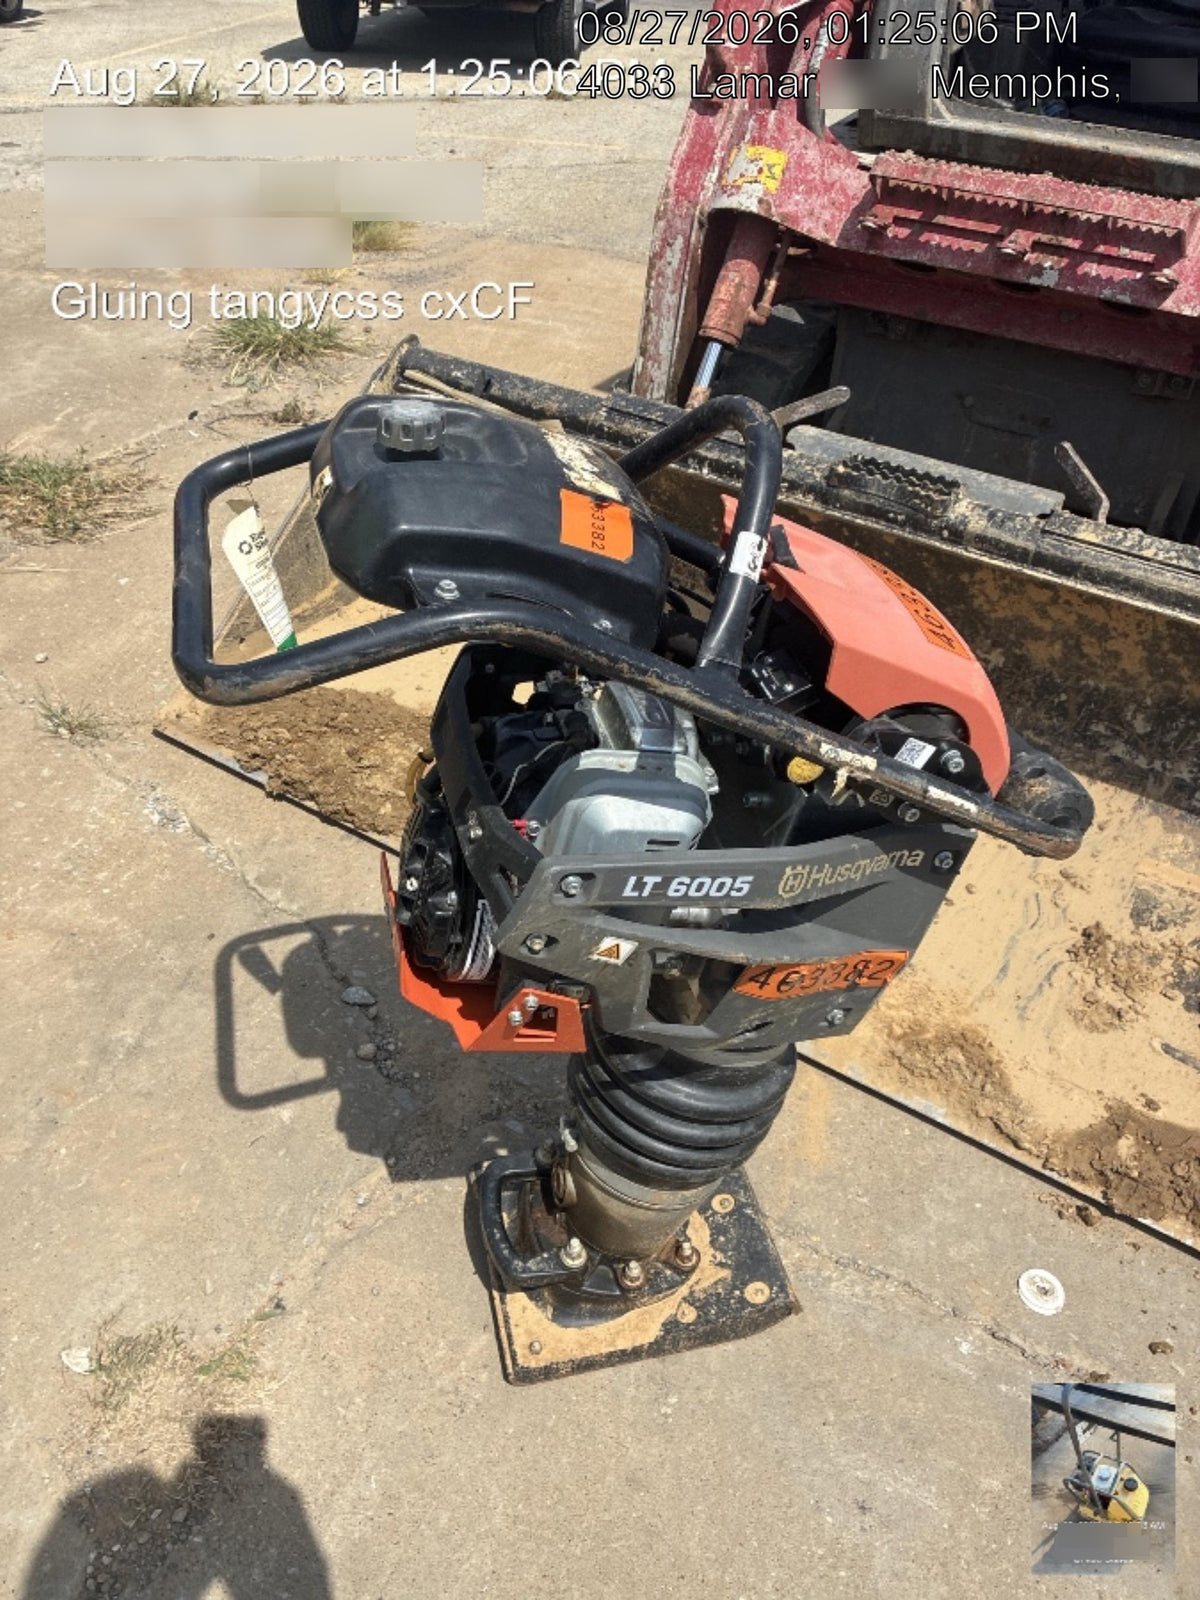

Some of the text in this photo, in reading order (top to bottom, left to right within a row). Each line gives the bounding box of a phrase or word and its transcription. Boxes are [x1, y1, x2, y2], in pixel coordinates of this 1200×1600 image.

[621, 849, 925, 897] LT 6005 Husqvarna
[748, 959, 895, 994] 463382
